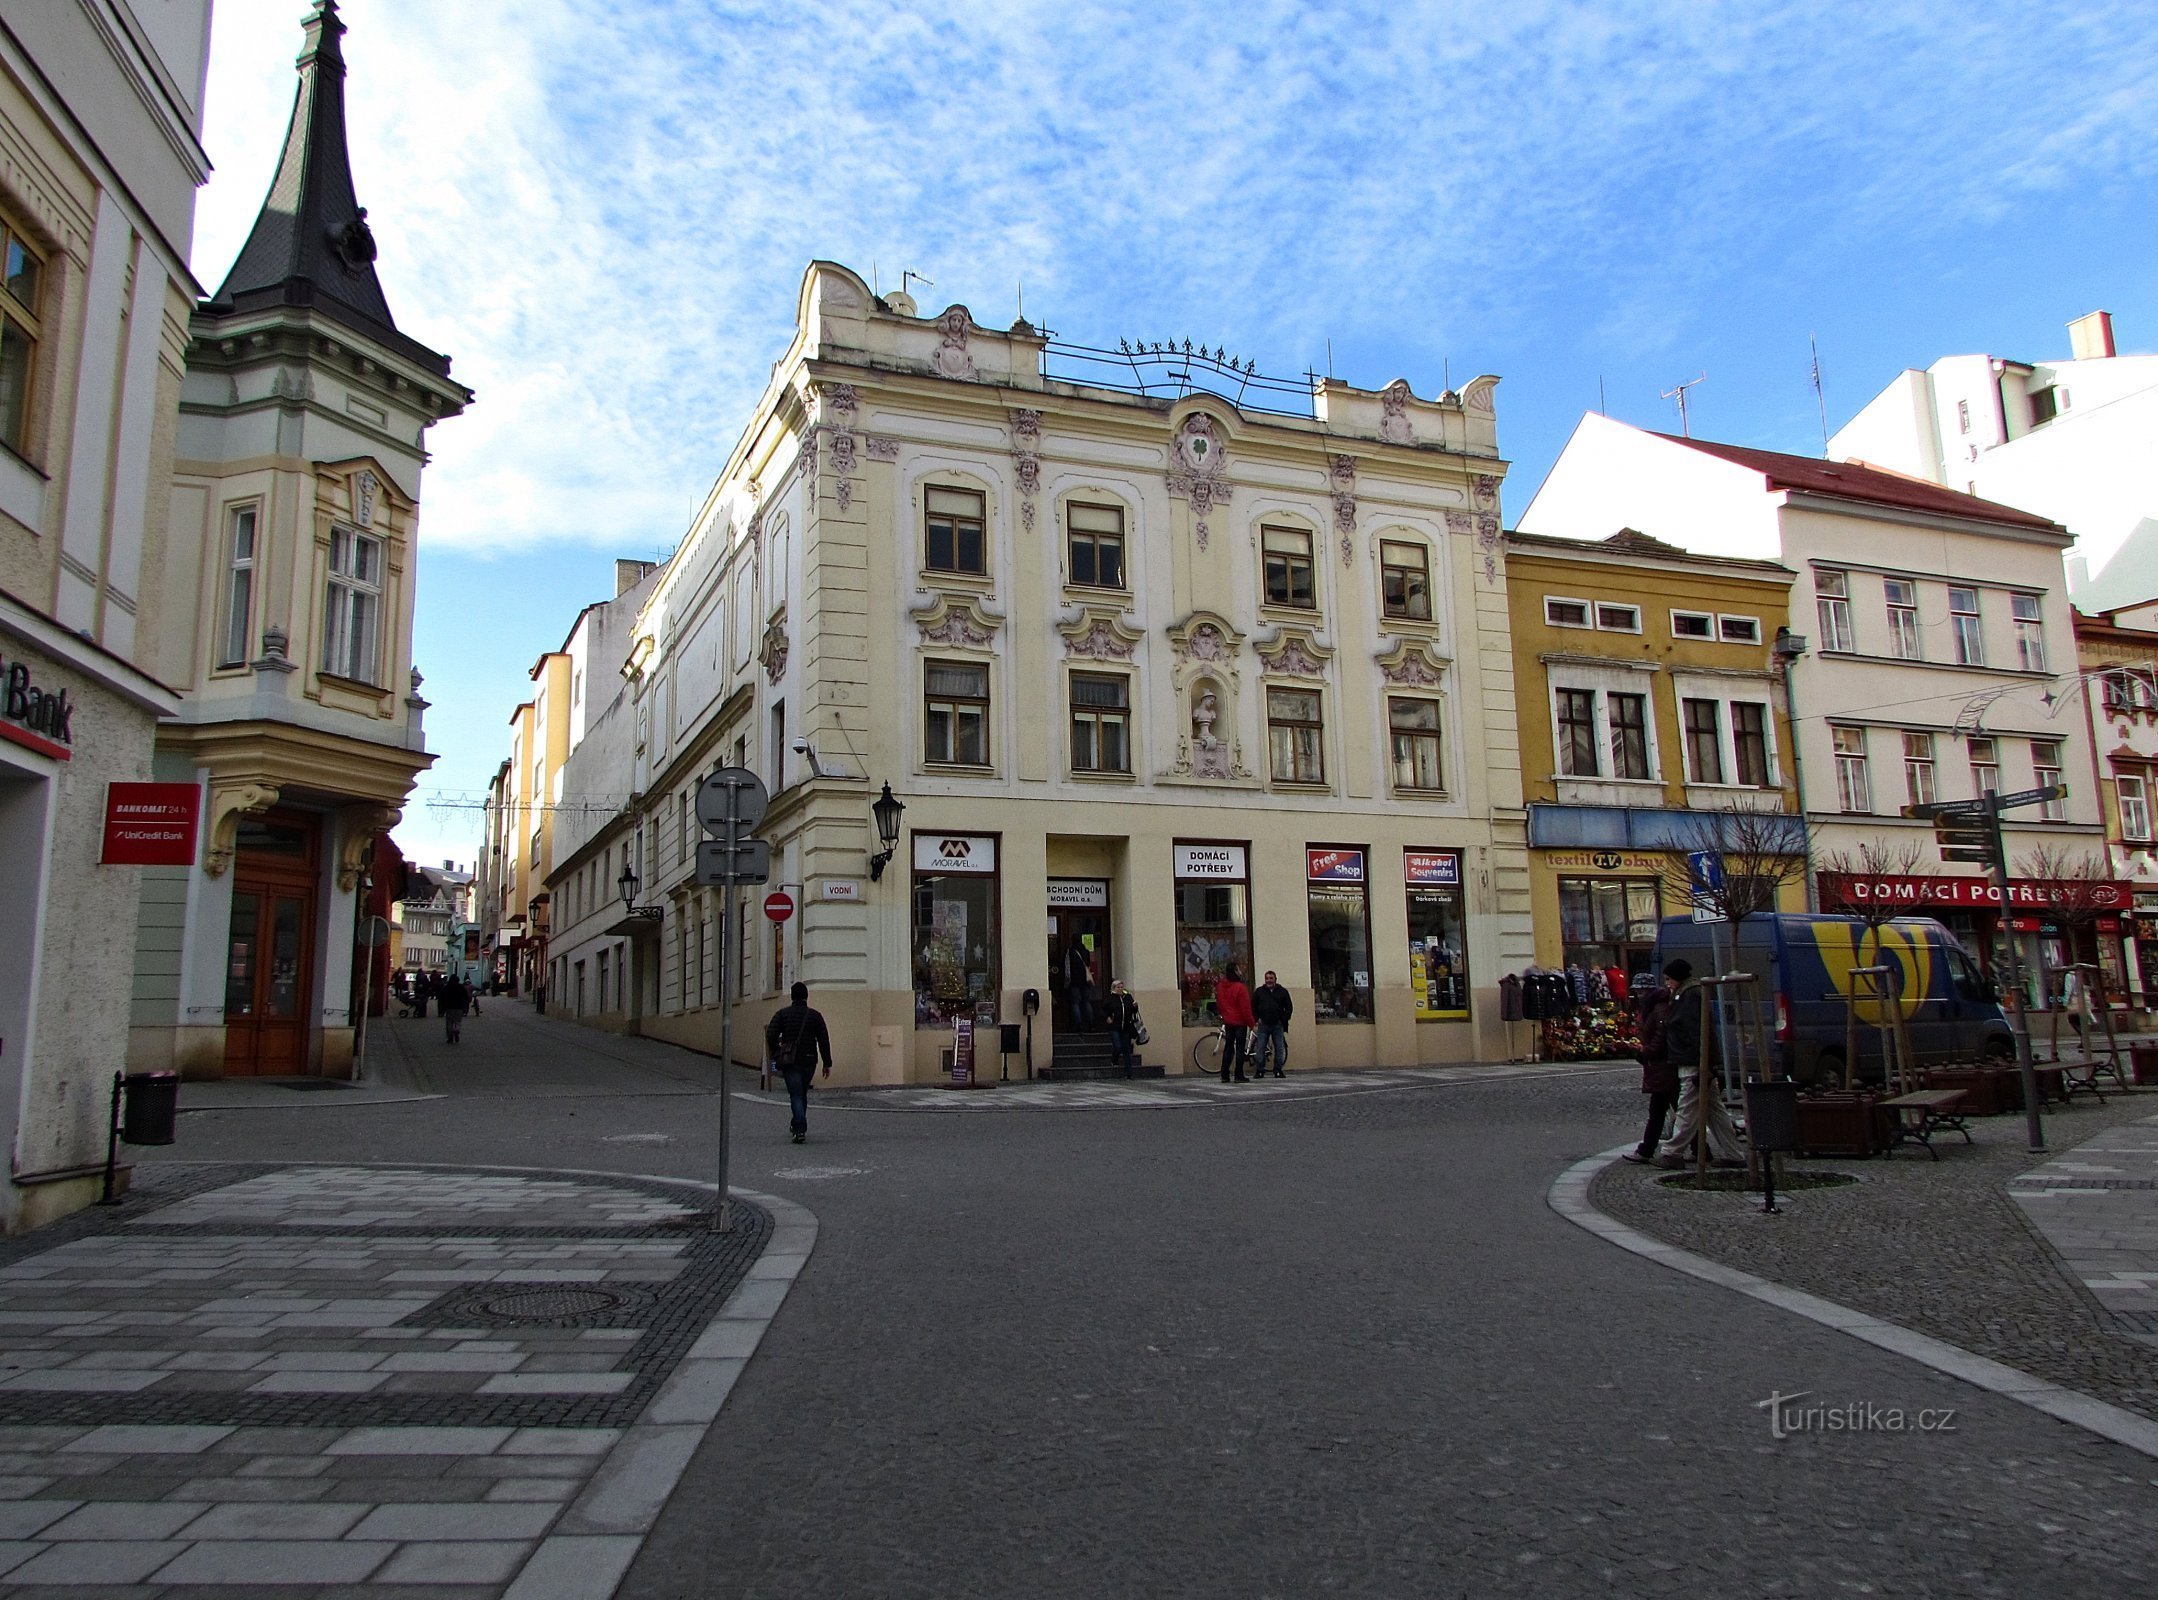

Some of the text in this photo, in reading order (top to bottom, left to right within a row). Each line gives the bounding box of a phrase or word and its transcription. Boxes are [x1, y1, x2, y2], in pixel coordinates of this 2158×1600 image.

[7, 661, 75, 745] Bank
[116, 805, 188, 814] BANKOMAT 24 h
[125, 831, 185, 840] UniCredit Bank
[1190, 851, 1230, 861] DOMÁCÍ
[1547, 853, 1591, 866] textil
[1624, 854, 1664, 868] obuv
[931, 859, 970, 868] MORAVEL
[1312, 853, 1338, 871] Free
[1411, 858, 1453, 867] Alkohol
[1187, 863, 1234, 873] POTŘEBY
[1334, 864, 1361, 877] Shop
[1410, 867, 1454, 878] Souvenirs
[829, 885, 852, 895] VODNÍ
[1047, 885, 1102, 895] BCHODNÍ DŮM
[1853, 881, 1959, 900] DOMÁCÍ
[1970, 884, 2079, 902] POTŘEBY
